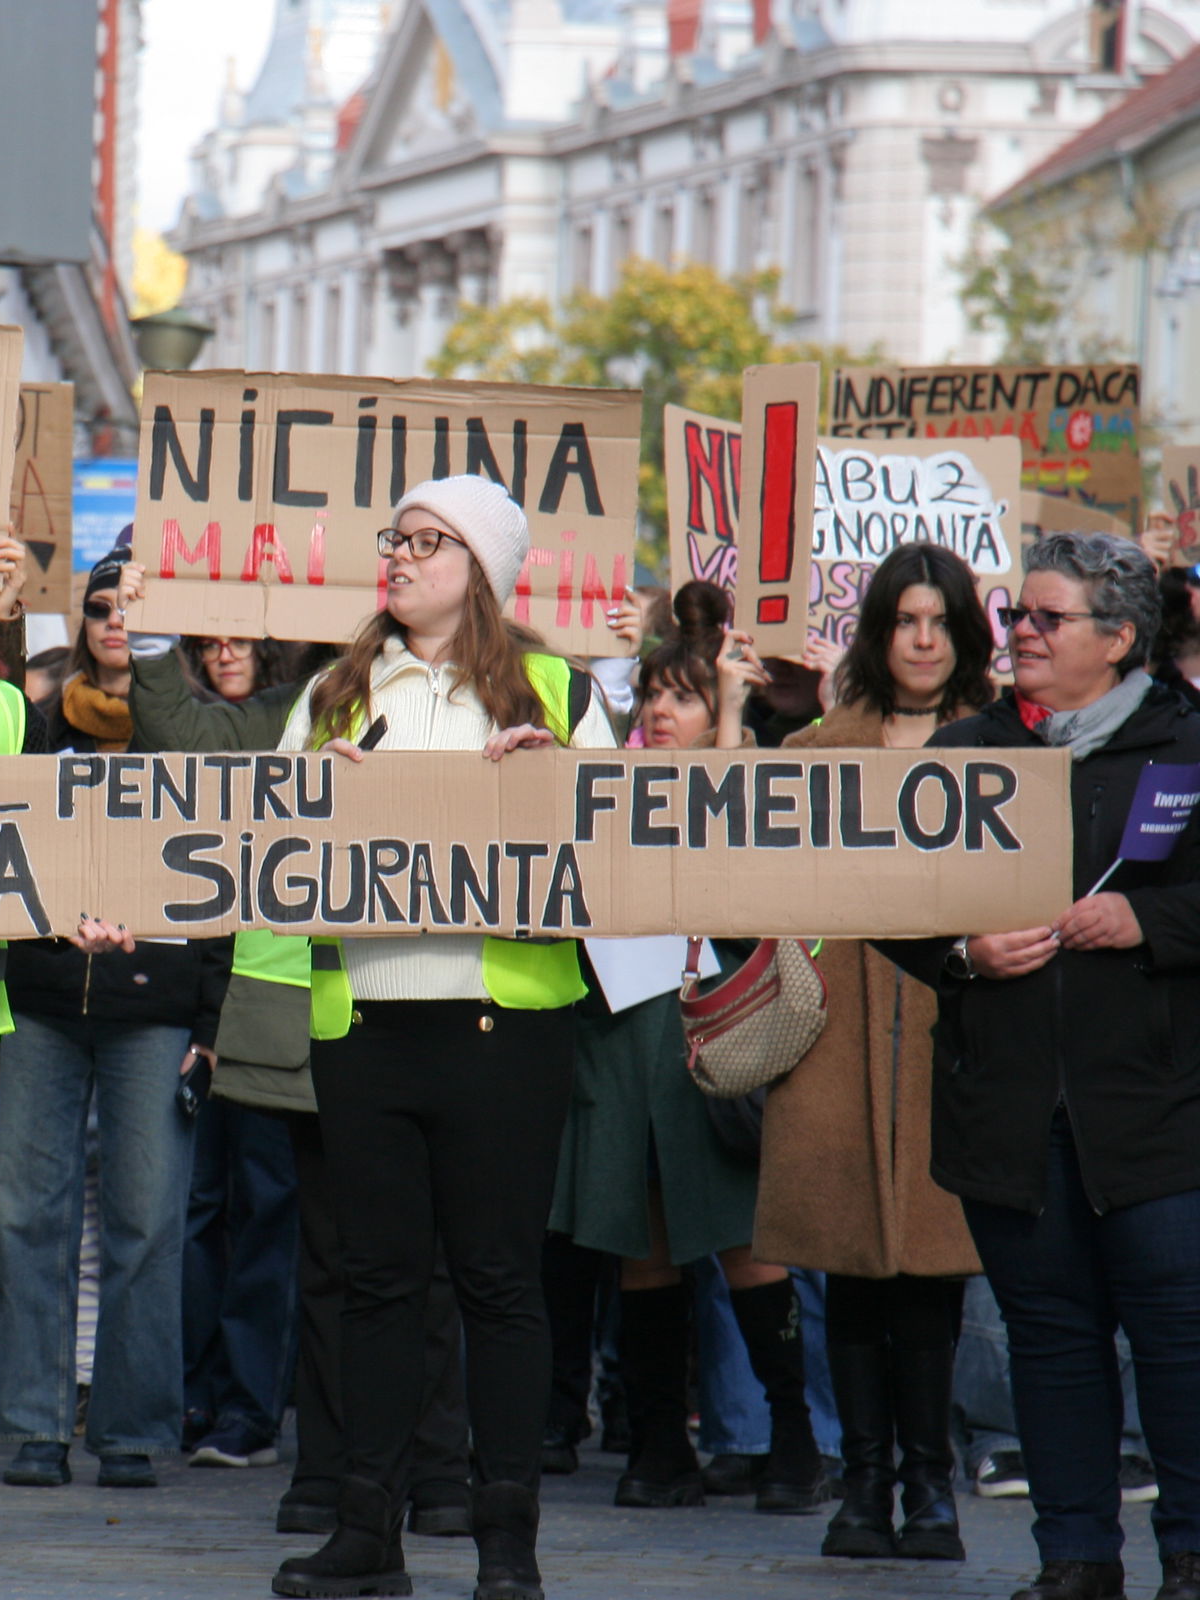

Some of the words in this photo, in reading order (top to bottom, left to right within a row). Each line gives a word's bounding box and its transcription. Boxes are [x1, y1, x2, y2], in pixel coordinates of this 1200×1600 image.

[832, 368, 1051, 419] INDIFERENT
[149, 388, 605, 517] NICIUNA
[159, 511, 332, 586] MAI
[57, 756, 334, 821] PENTRU
[574, 761, 1022, 852] FEMEILOR
